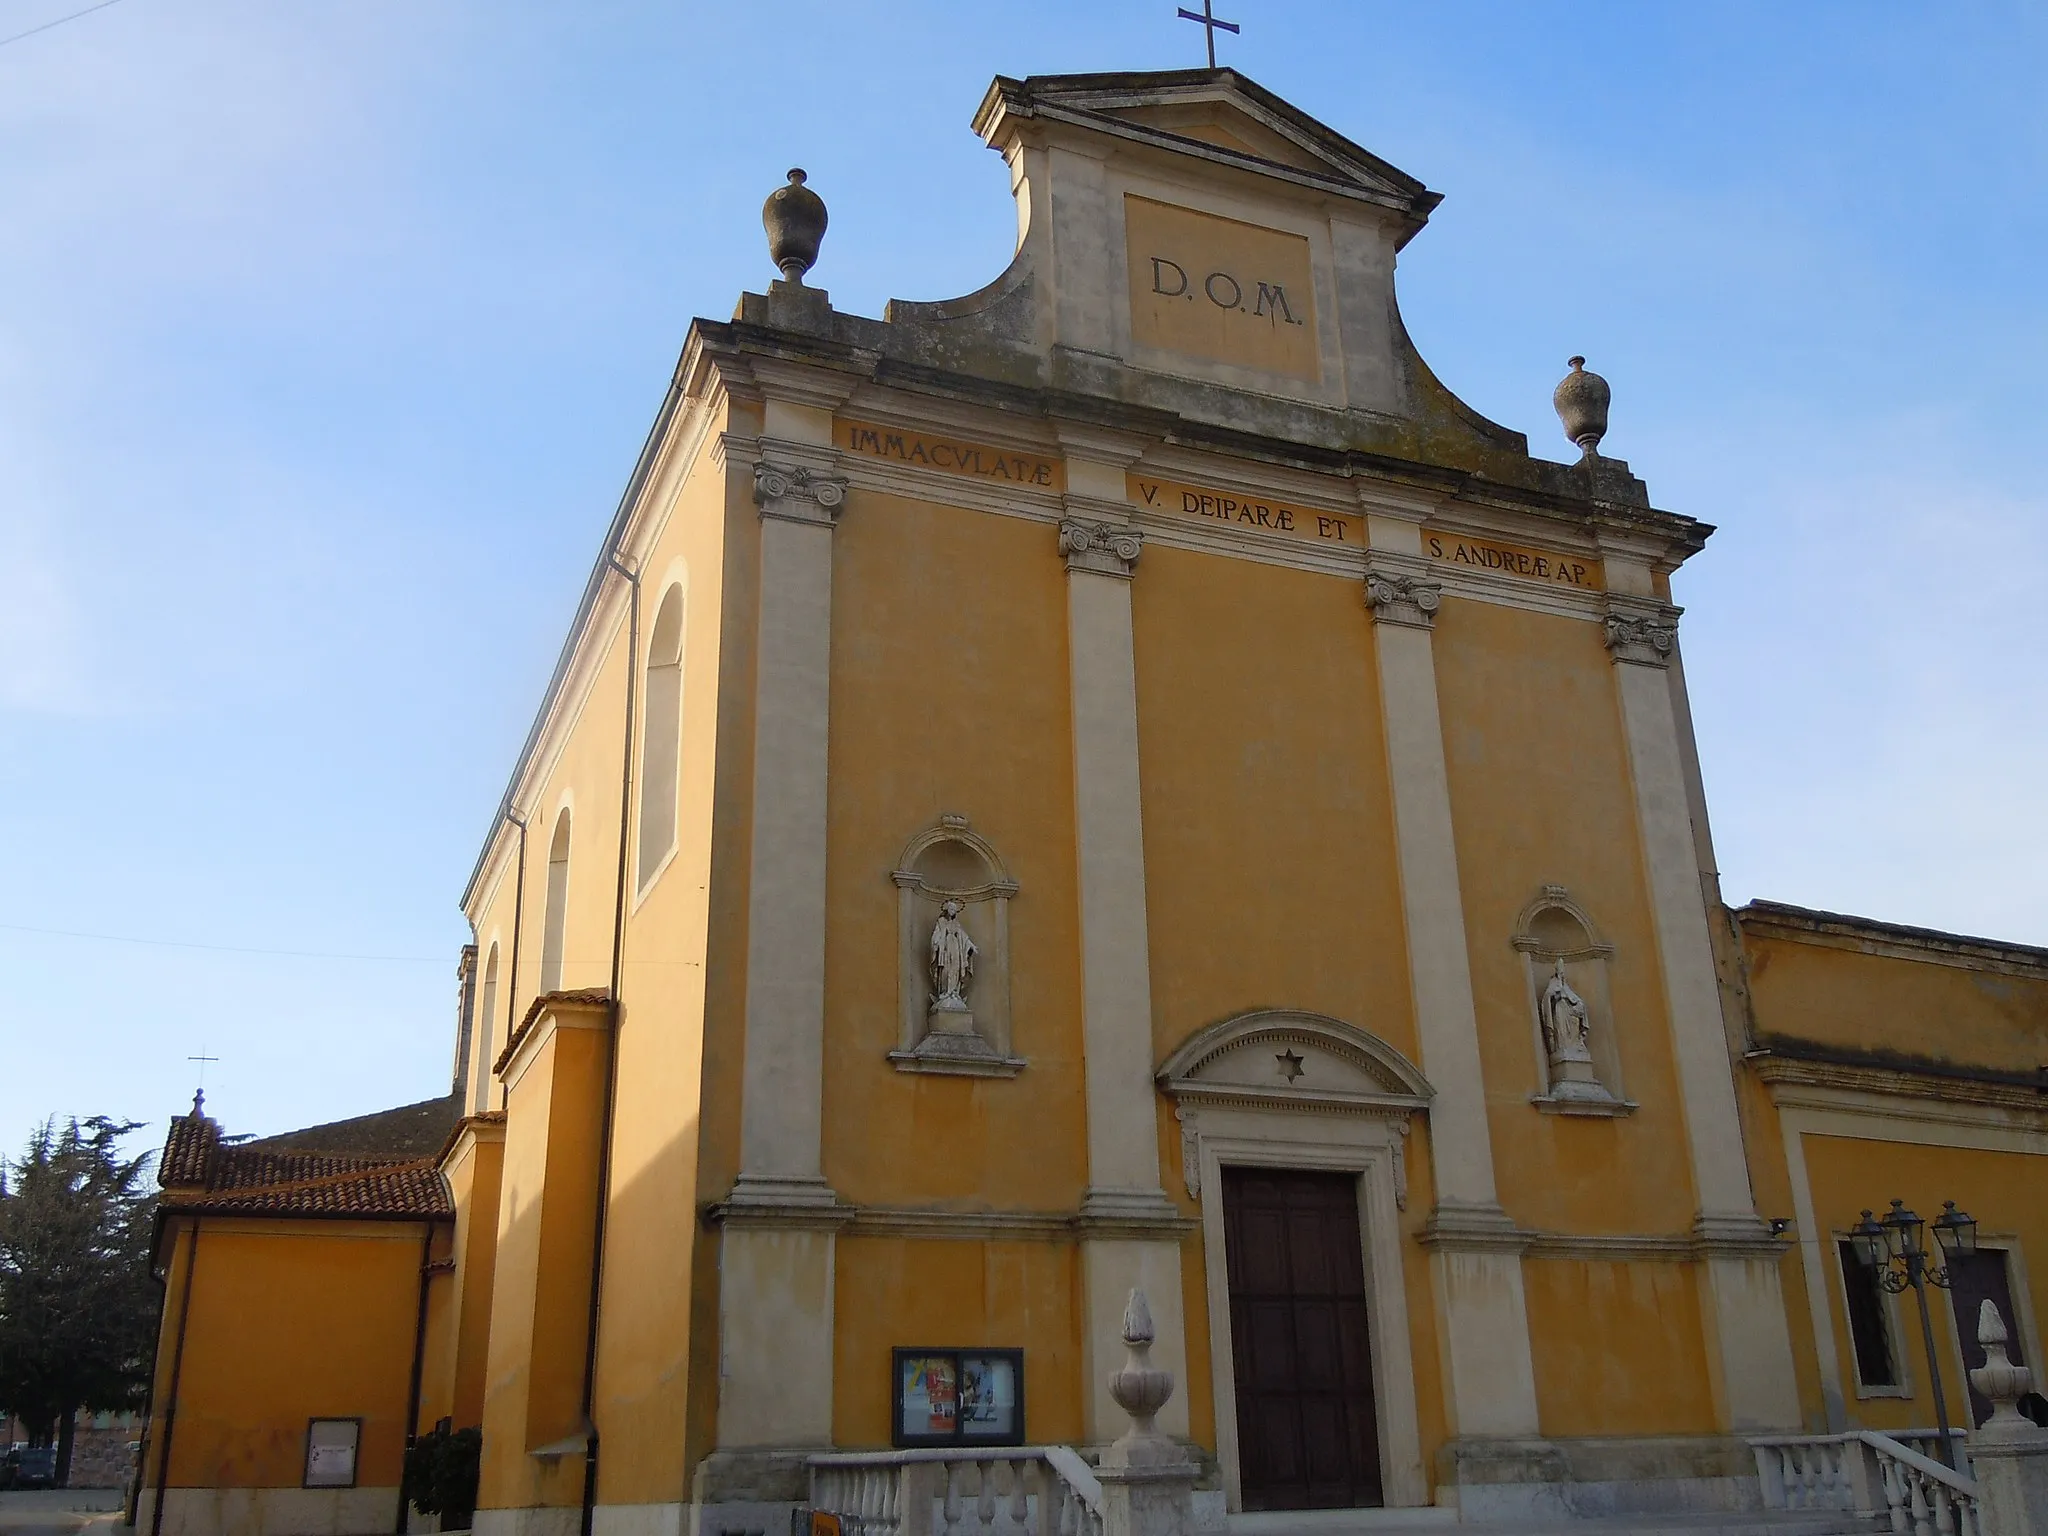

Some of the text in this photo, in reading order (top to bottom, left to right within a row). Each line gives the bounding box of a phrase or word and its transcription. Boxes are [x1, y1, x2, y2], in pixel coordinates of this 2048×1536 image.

[1139, 483, 1161, 507] V.
[1181, 491, 1295, 531] DEIPARÆ
[1316, 516, 1348, 540] ET
[1556, 562, 1592, 586] AP.
